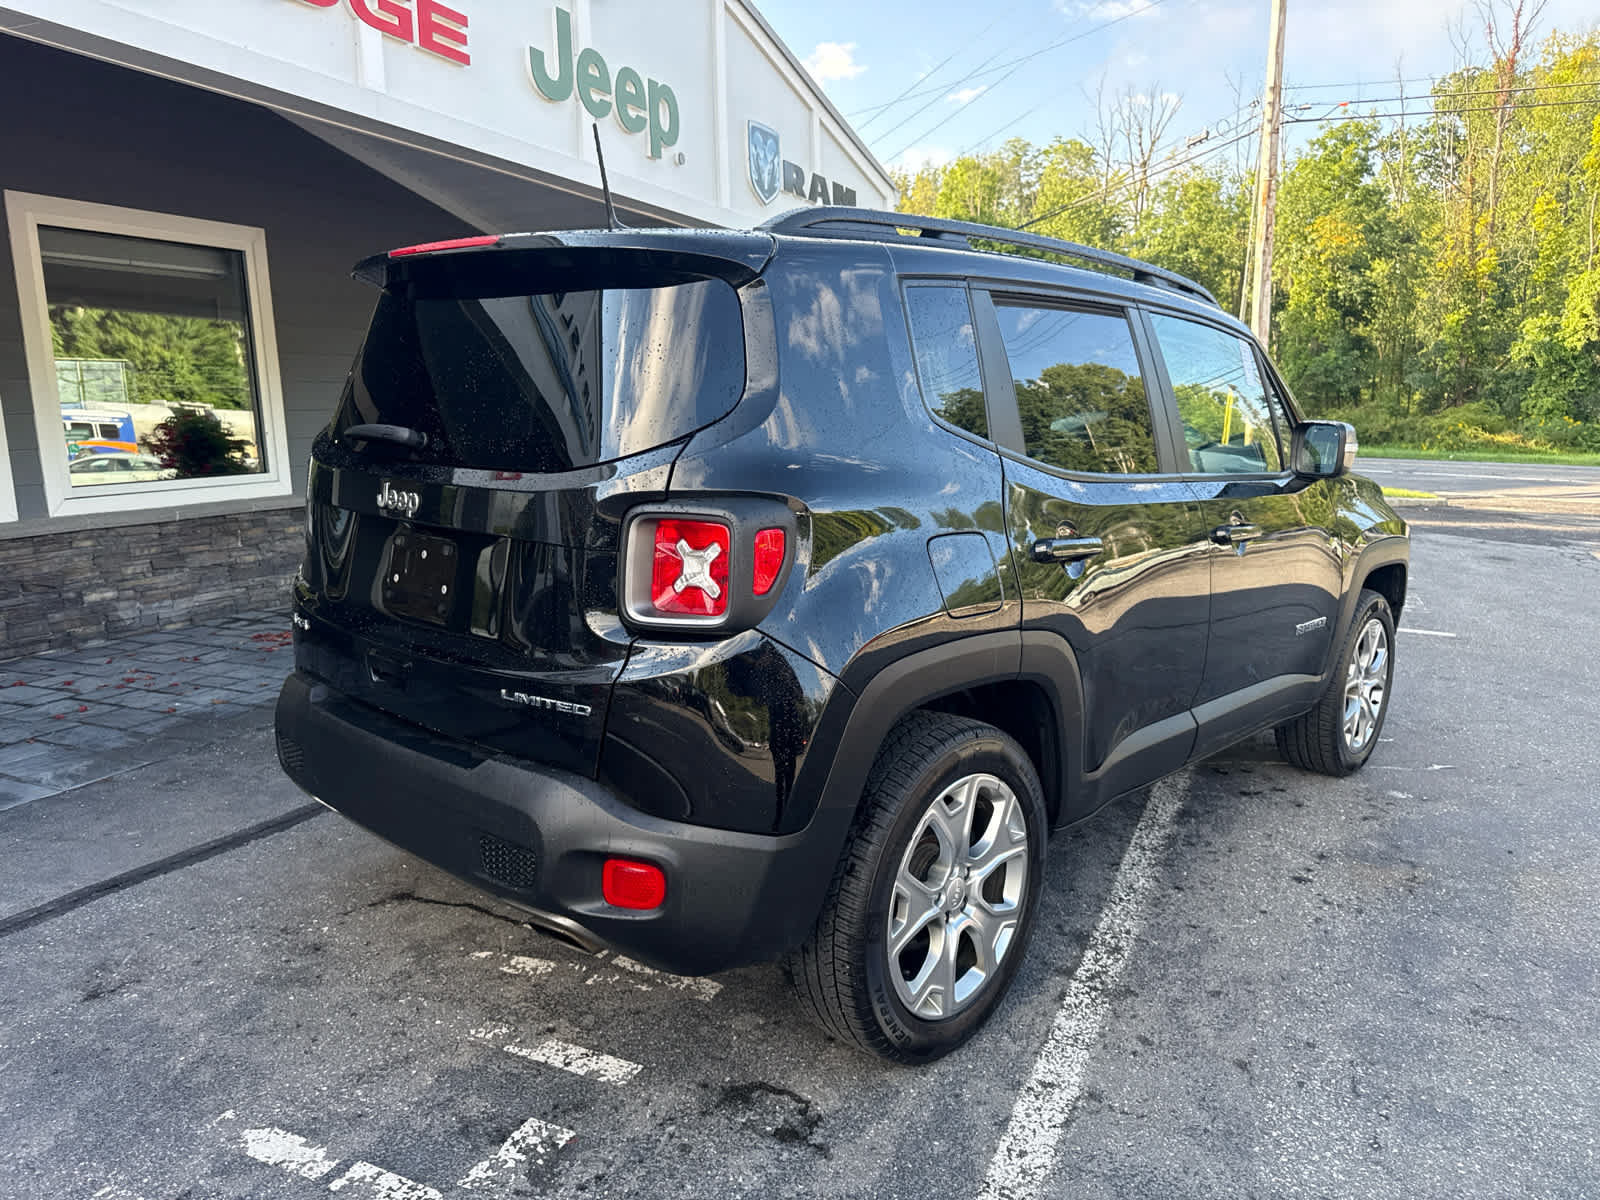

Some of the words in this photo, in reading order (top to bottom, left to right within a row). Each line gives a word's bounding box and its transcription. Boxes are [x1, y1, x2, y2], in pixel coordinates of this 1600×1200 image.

[529, 7, 679, 159] Jeep
[782, 159, 857, 207] RAM
[376, 481, 420, 518] Jeep
[500, 688, 592, 716] LIMITED
